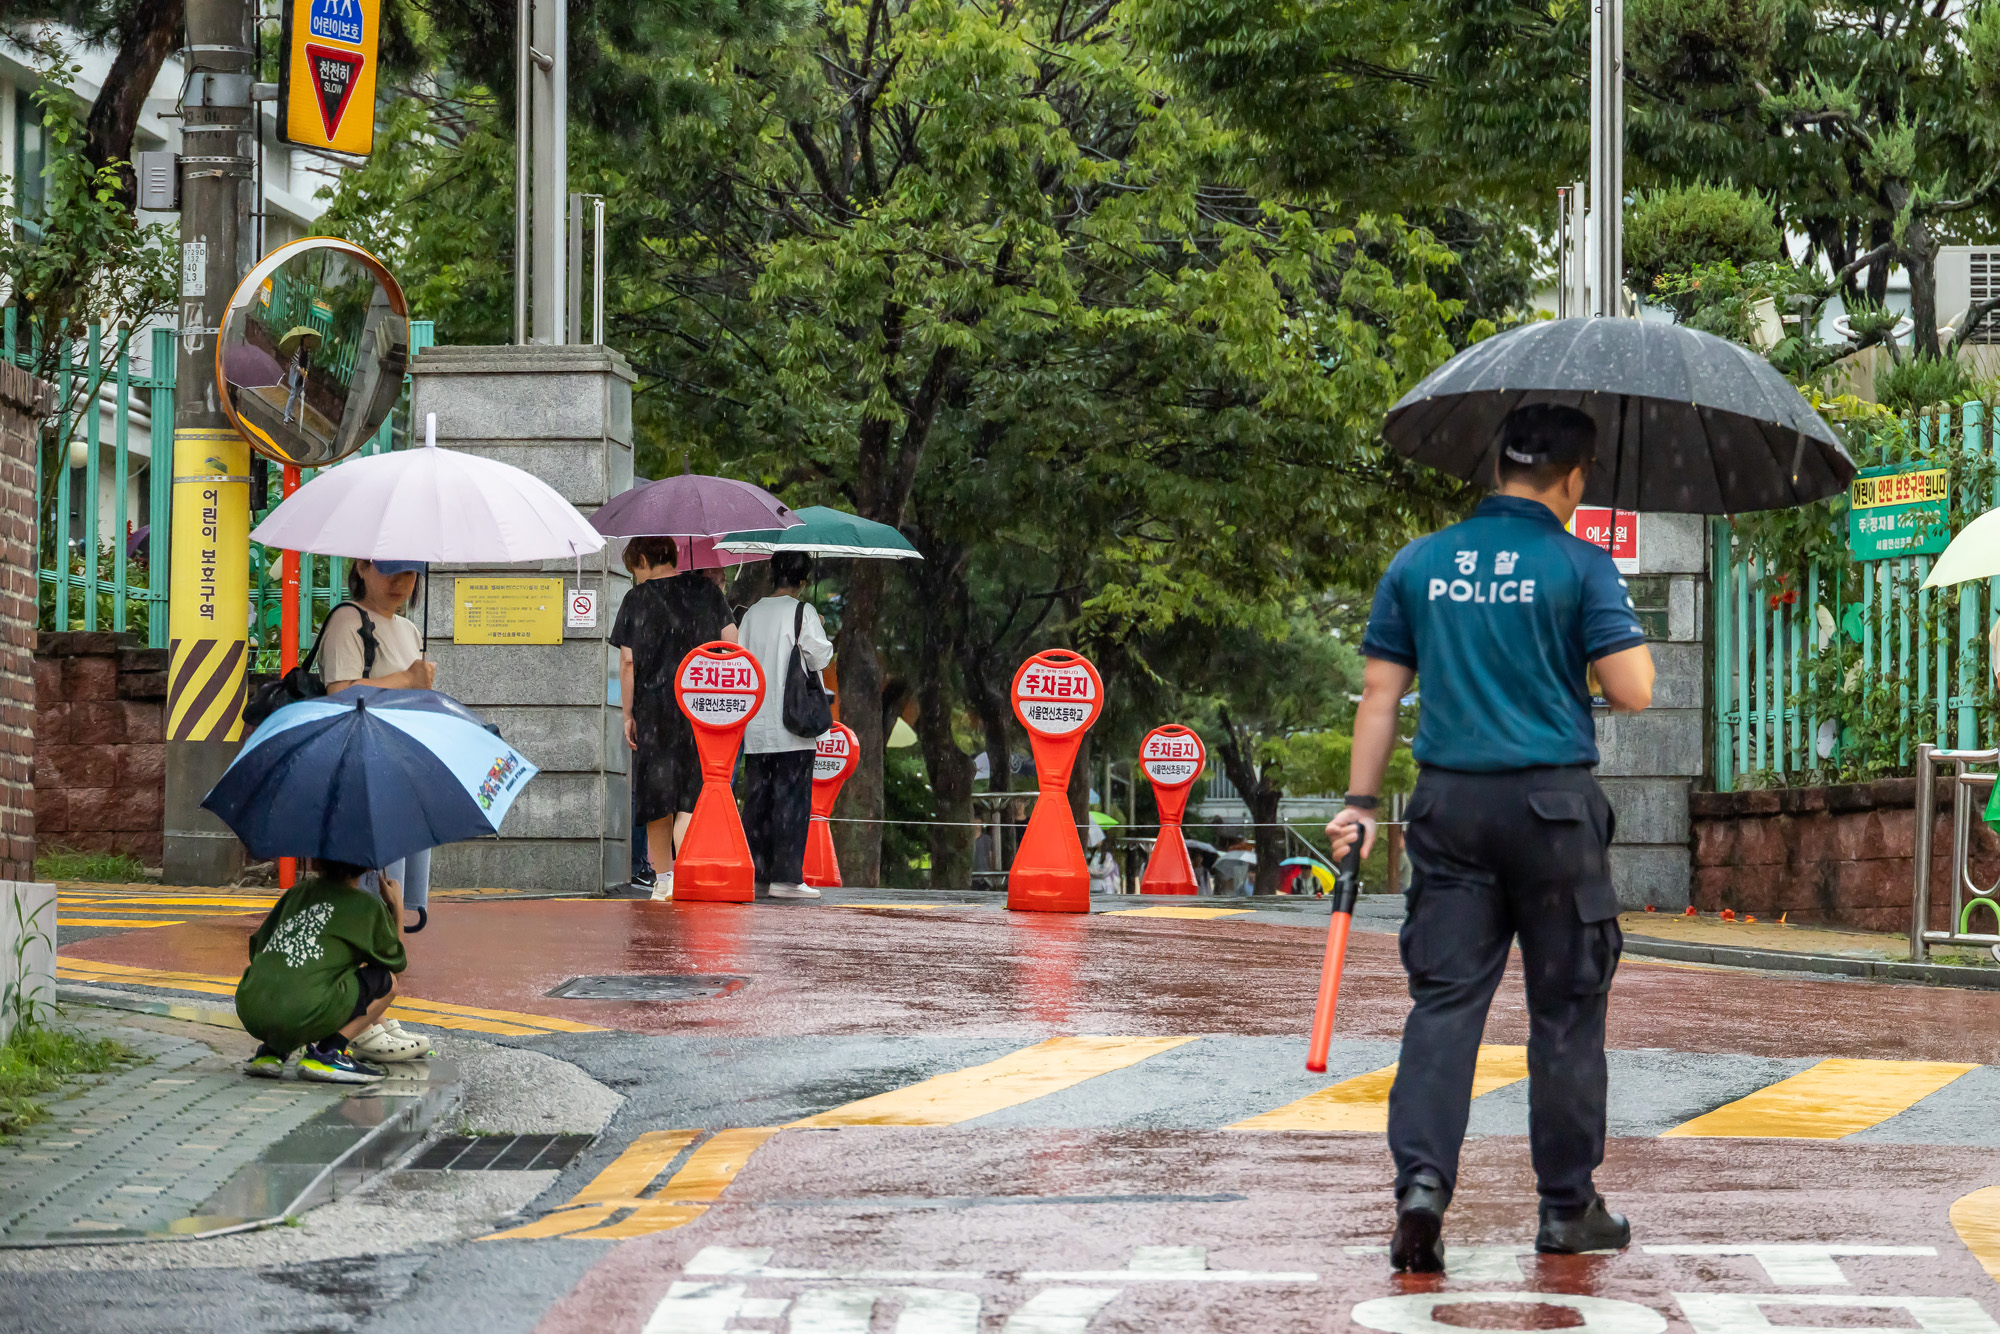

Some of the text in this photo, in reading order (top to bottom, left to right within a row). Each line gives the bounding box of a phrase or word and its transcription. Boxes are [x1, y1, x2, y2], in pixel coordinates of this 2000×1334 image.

[313, 16, 360, 40] 어린이보호
[319, 60, 350, 84] 천천히
[323, 81, 343, 95] SLOW
[186, 272, 198, 282] L3
[1853, 474, 1946, 505] 어린이 안전 보호구역입니다
[202, 490, 217, 543] 어린이
[1586, 526, 1628, 543] 에스원
[1454, 550, 1520, 575] 경찰
[200, 549, 216, 621] 보호구역
[1428, 578, 1536, 604] POLICE
[690, 666, 751, 688] 주차금지
[1026, 674, 1088, 697] 주차금지
[692, 698, 747, 713] 서울연신초등학교
[1028, 705, 1083, 722] 서울연신초등학교
[1149, 742, 1194, 757] 주차금지
[1151, 764, 1191, 775] 서울연신초등학교
